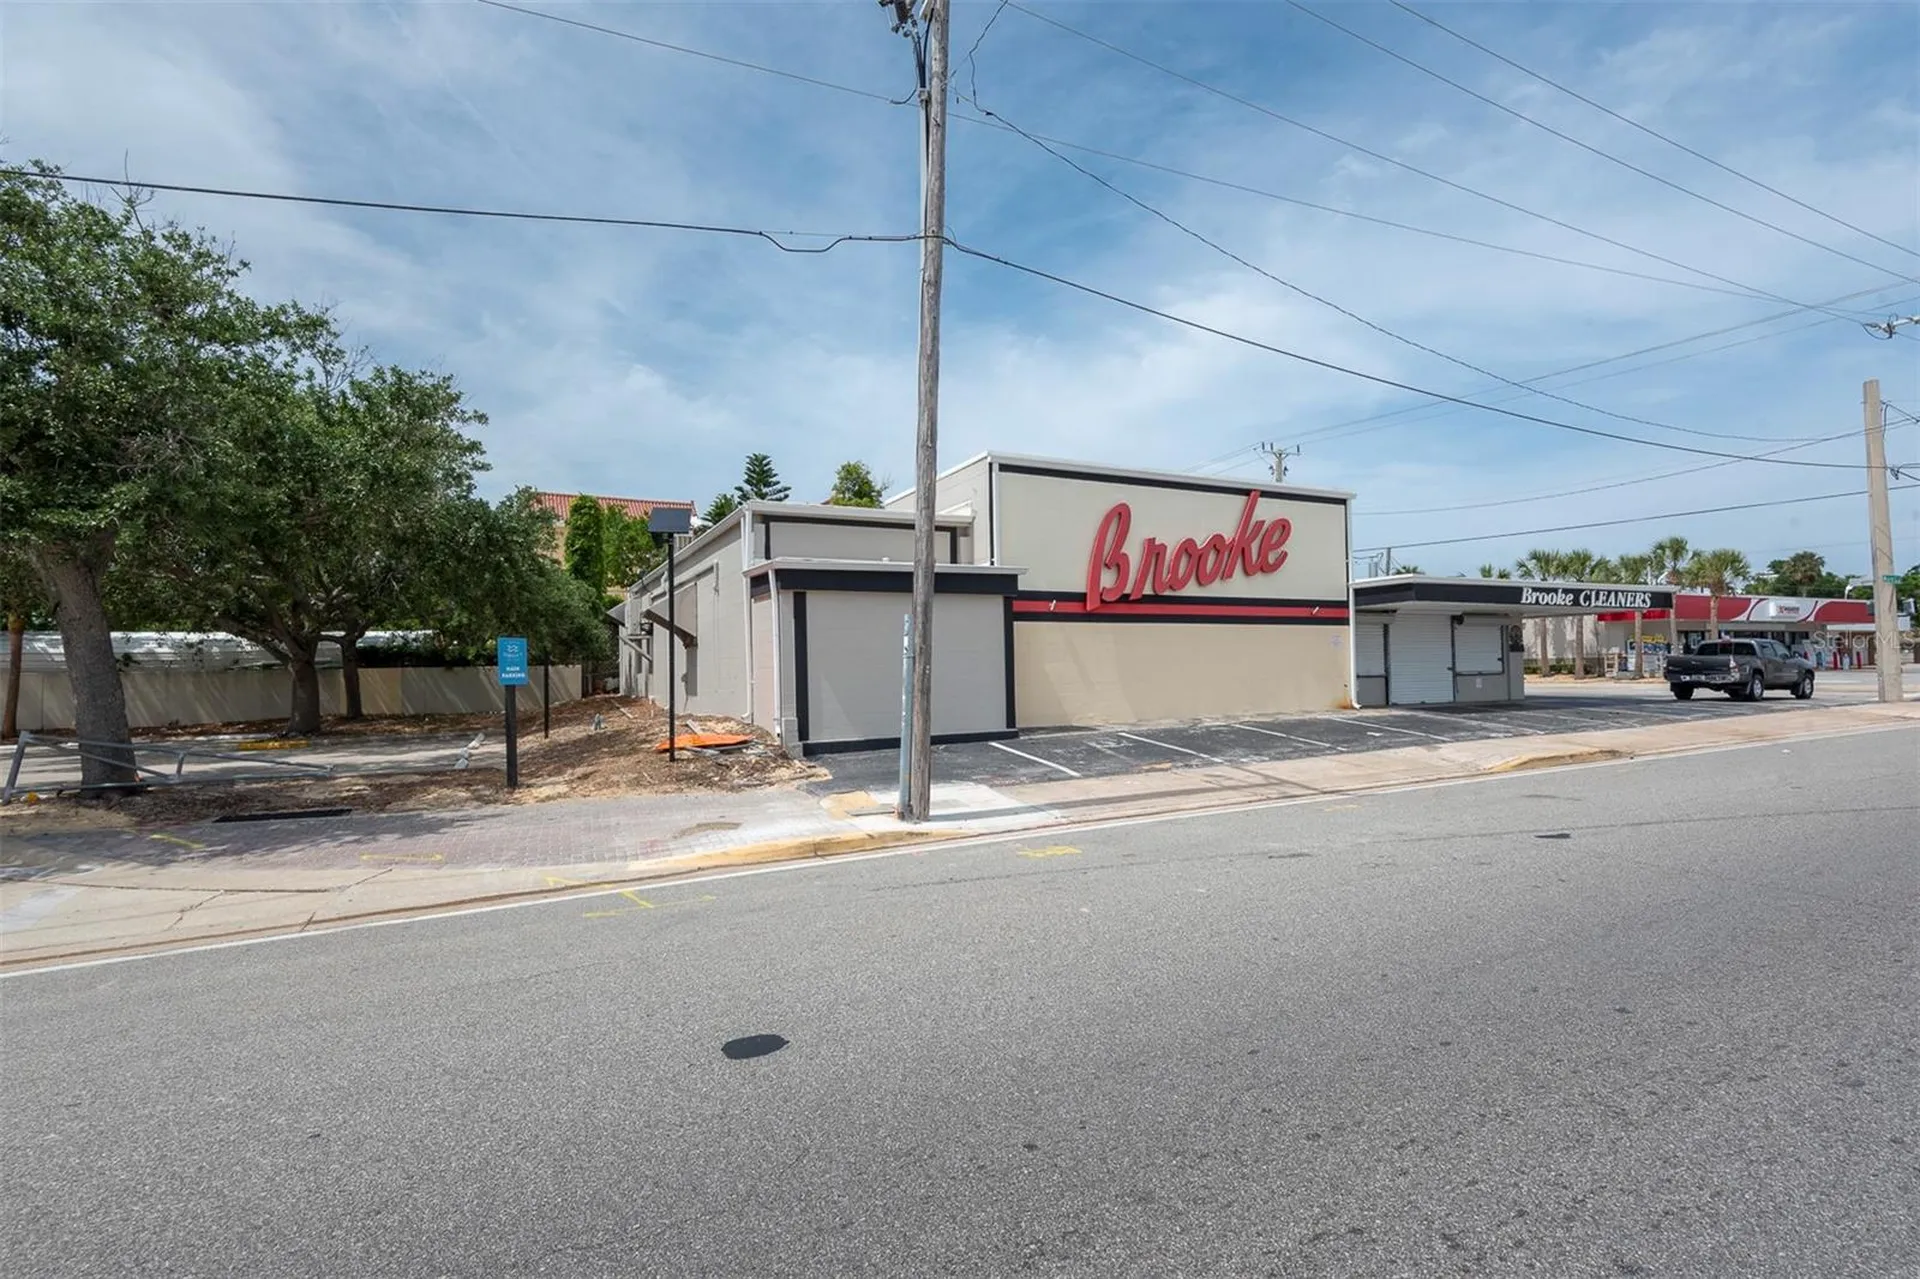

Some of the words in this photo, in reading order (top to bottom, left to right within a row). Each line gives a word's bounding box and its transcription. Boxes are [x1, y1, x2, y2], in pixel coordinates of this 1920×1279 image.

[1086, 488, 1292, 611] Brooke
[1520, 587, 1574, 606] Brooke
[1579, 589, 1652, 608] CLEANERS
